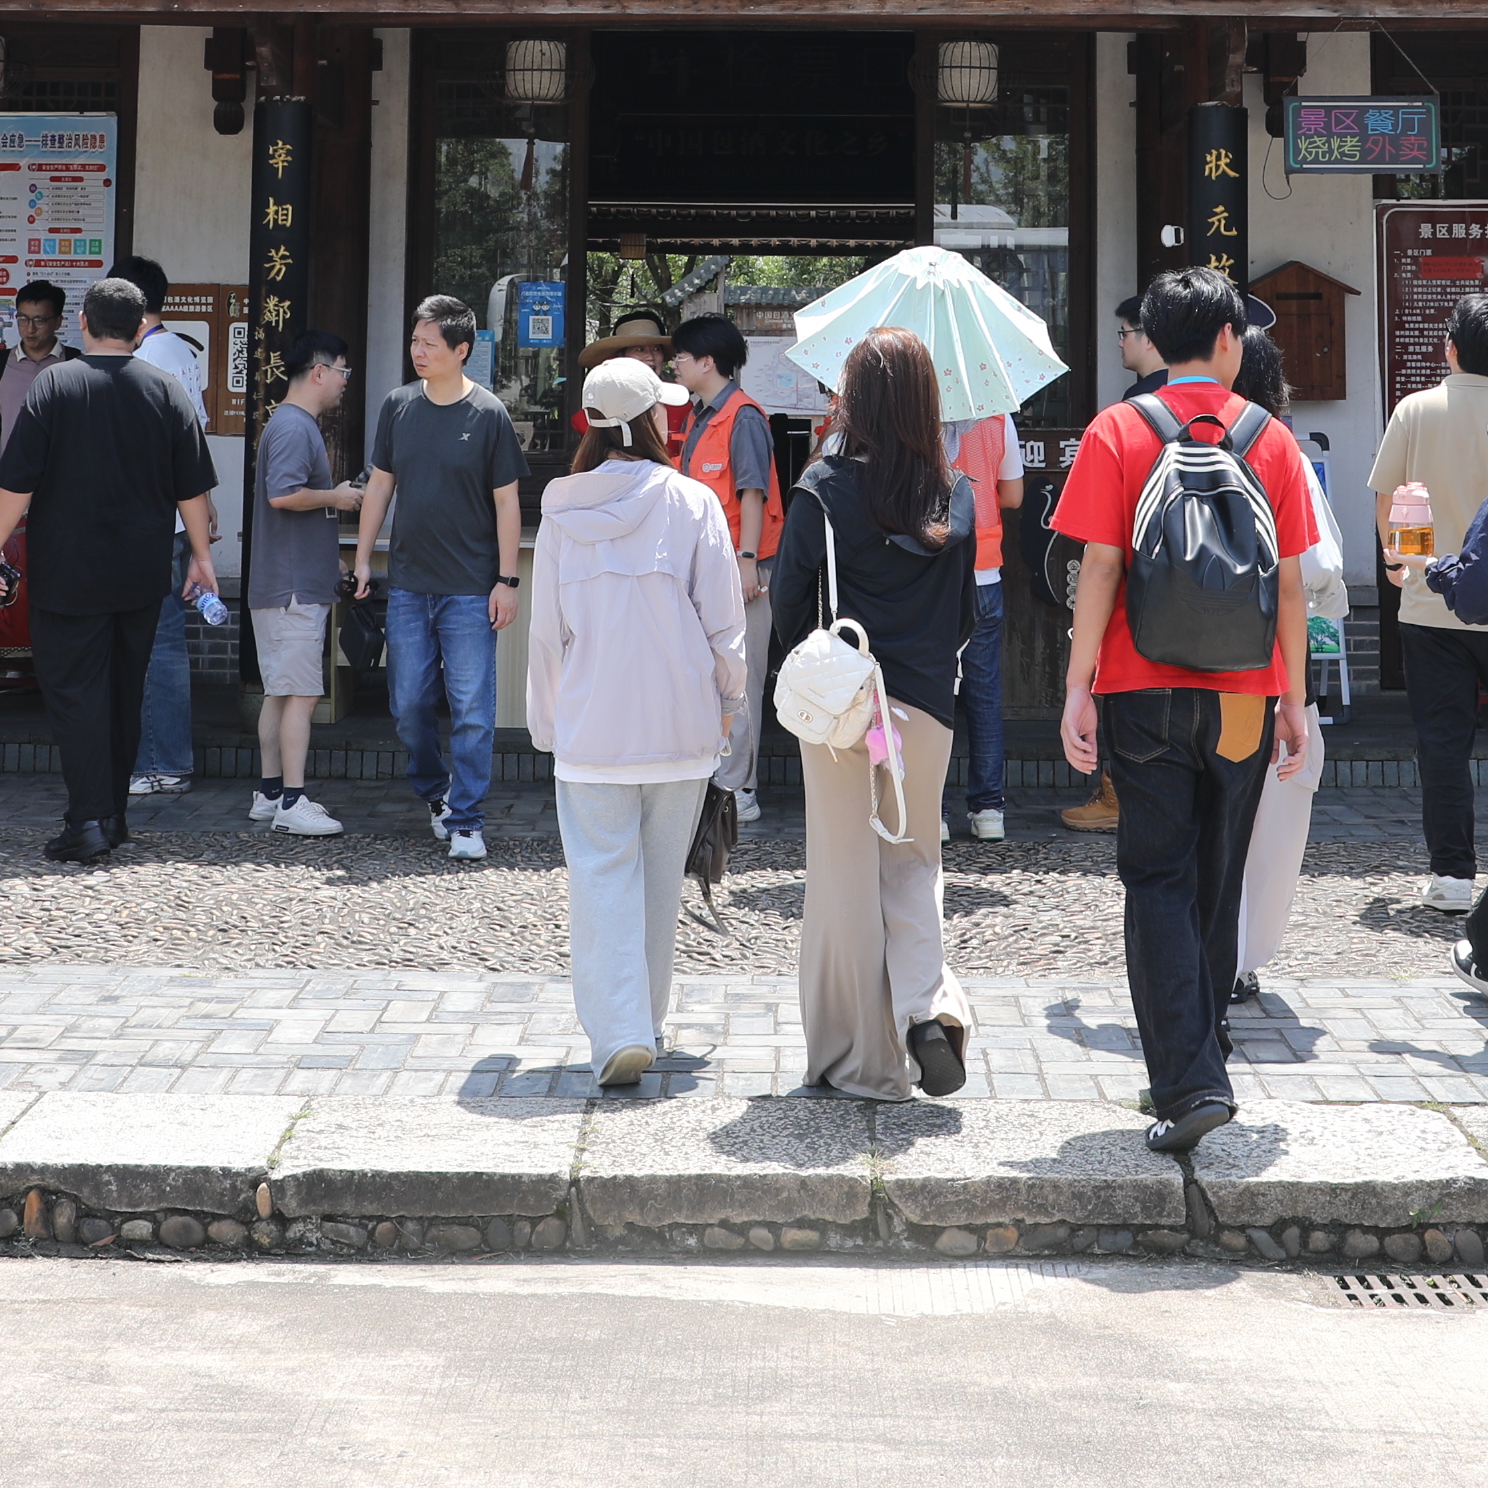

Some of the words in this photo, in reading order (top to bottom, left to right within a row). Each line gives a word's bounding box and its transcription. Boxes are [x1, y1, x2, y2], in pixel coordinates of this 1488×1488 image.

[1297, 108, 1427, 135] 景区餐厅
[1297, 135, 1427, 162] 烧烤外卖
